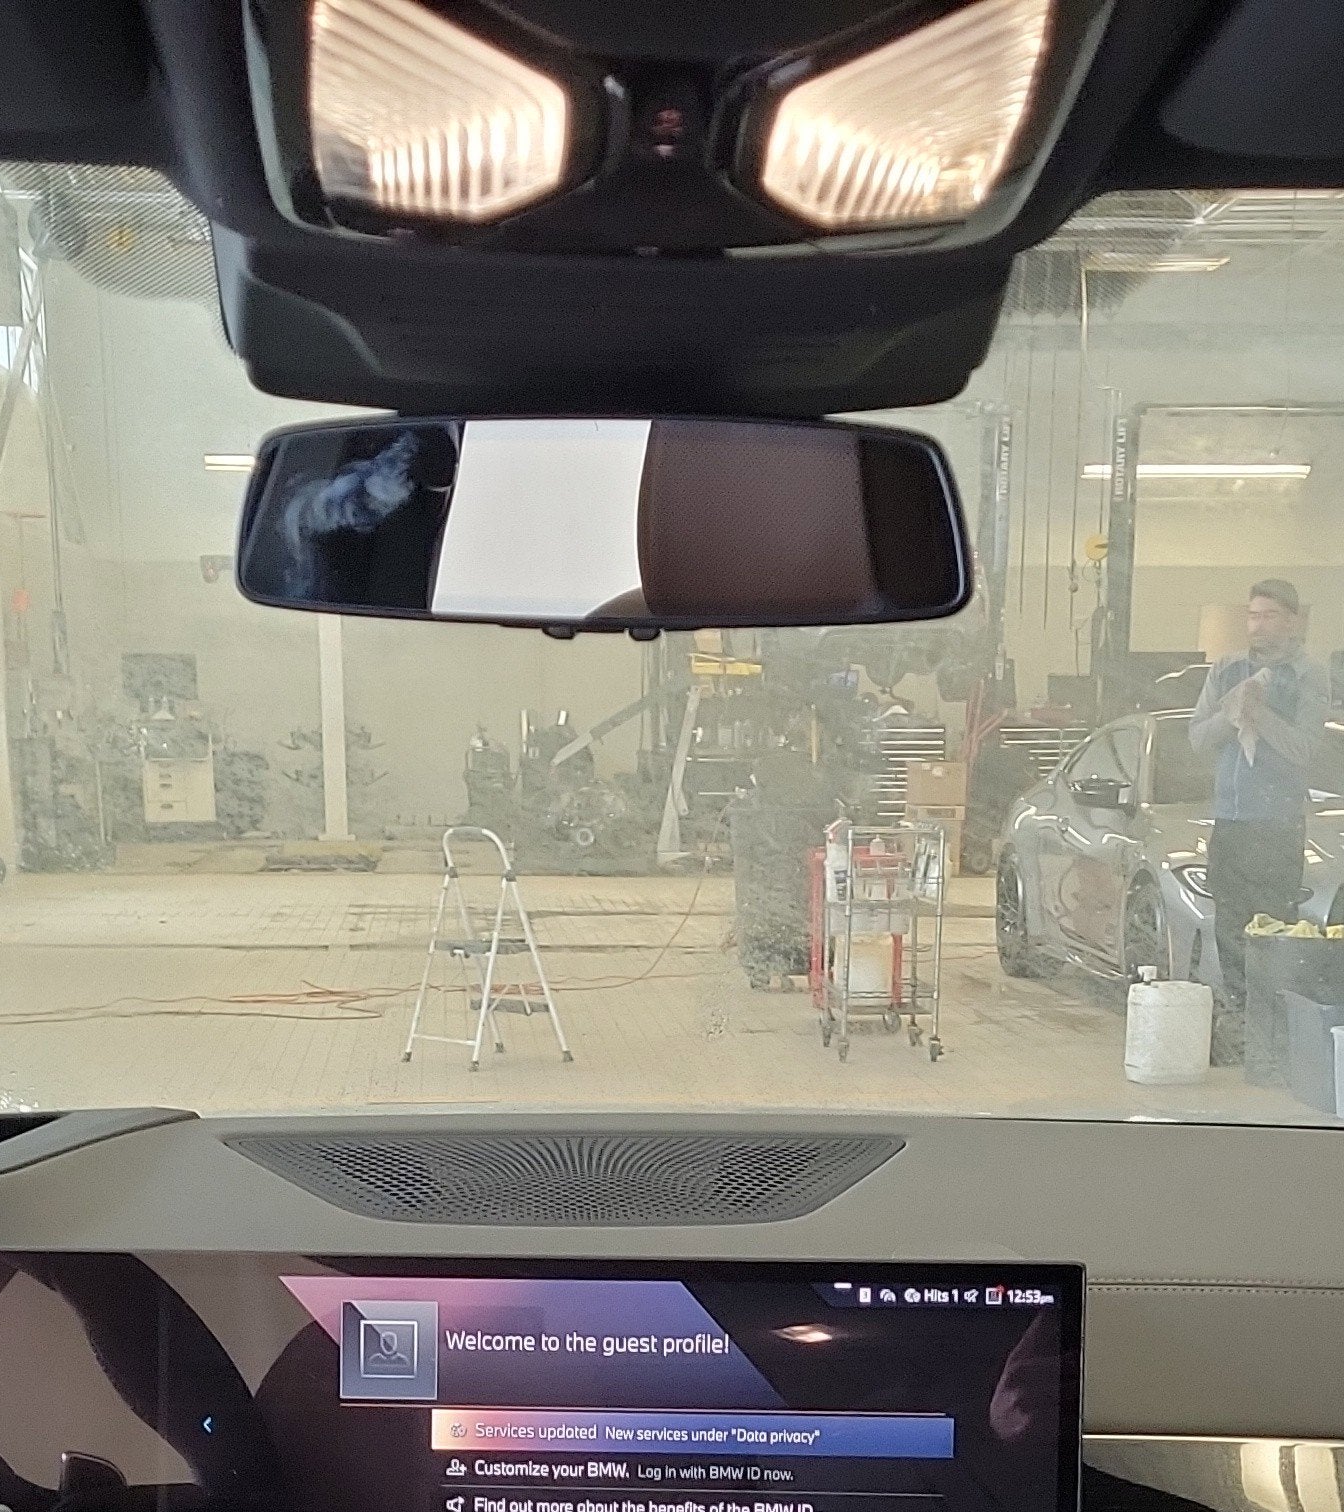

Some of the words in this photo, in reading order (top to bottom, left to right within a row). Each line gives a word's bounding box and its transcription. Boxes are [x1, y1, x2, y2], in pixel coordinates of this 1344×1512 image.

[924, 1289, 949, 1303] Hits
[952, 1289, 959, 1303] 1
[445, 1330, 535, 1351] Welcome
[541, 1333, 560, 1351] to
[566, 1332, 597, 1352] the
[602, 1335, 658, 1356] guest
[663, 1334, 729, 1357] profile!
[475, 1423, 535, 1438] Services
[538, 1424, 597, 1441] updated
[606, 1426, 634, 1440] New
[636, 1427, 688, 1441] services
[691, 1428, 728, 1442] under
[731, 1428, 767, 1443] "Data
[770, 1429, 820, 1445] privacy"
[474, 1460, 549, 1476] Customize
[552, 1462, 585, 1479] your
[587, 1461, 630, 1478] BMW.
[638, 1465, 661, 1480] Log
[665, 1465, 676, 1479] in
[680, 1466, 706, 1480] with
[709, 1466, 744, 1480] BMW
[747, 1467, 761, 1480] ID
[764, 1469, 794, 1481] now.
